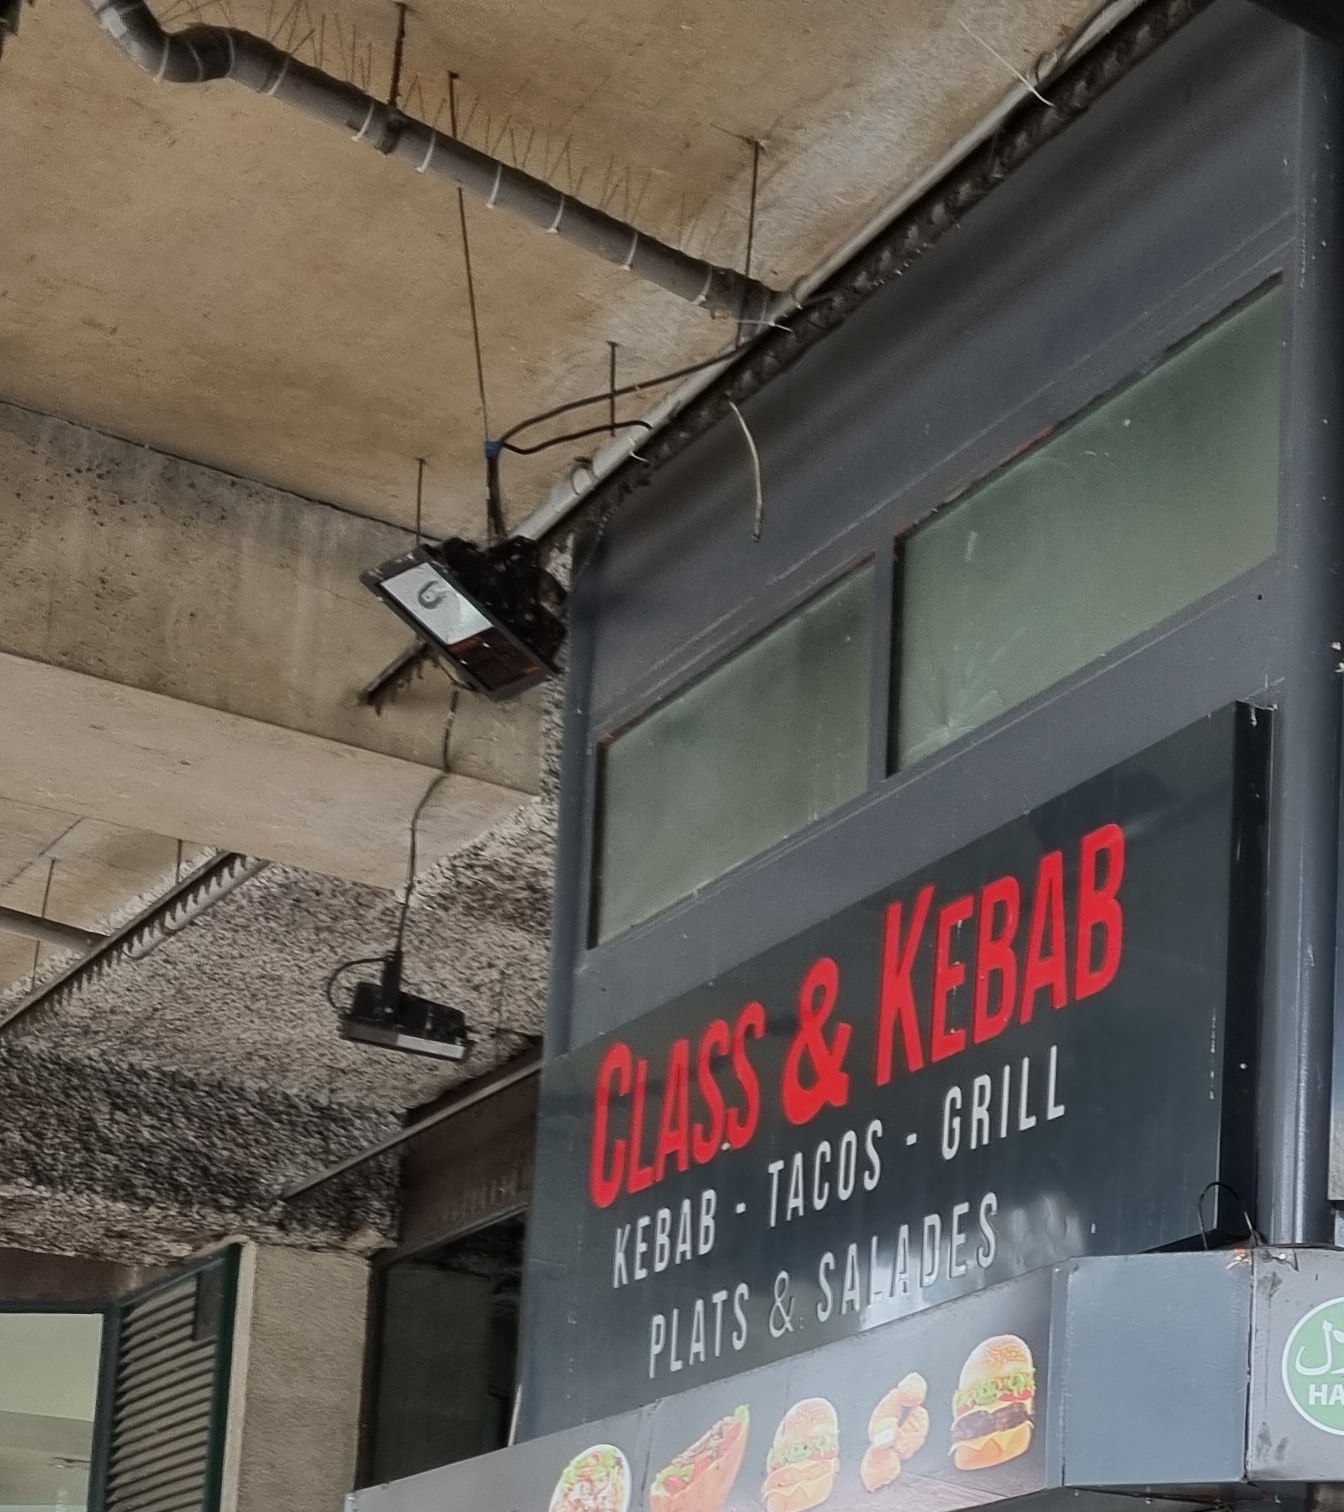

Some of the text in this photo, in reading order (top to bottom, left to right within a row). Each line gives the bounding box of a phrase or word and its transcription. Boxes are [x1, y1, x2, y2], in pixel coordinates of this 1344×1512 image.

[589, 823, 1126, 1208] CLASS & KEBAB
[611, 1188, 717, 1288] KEBAB
[767, 1119, 884, 1228] TACOS
[941, 1045, 1066, 1161] GRILL
[649, 1191, 998, 1378] PLATS & SALADES
